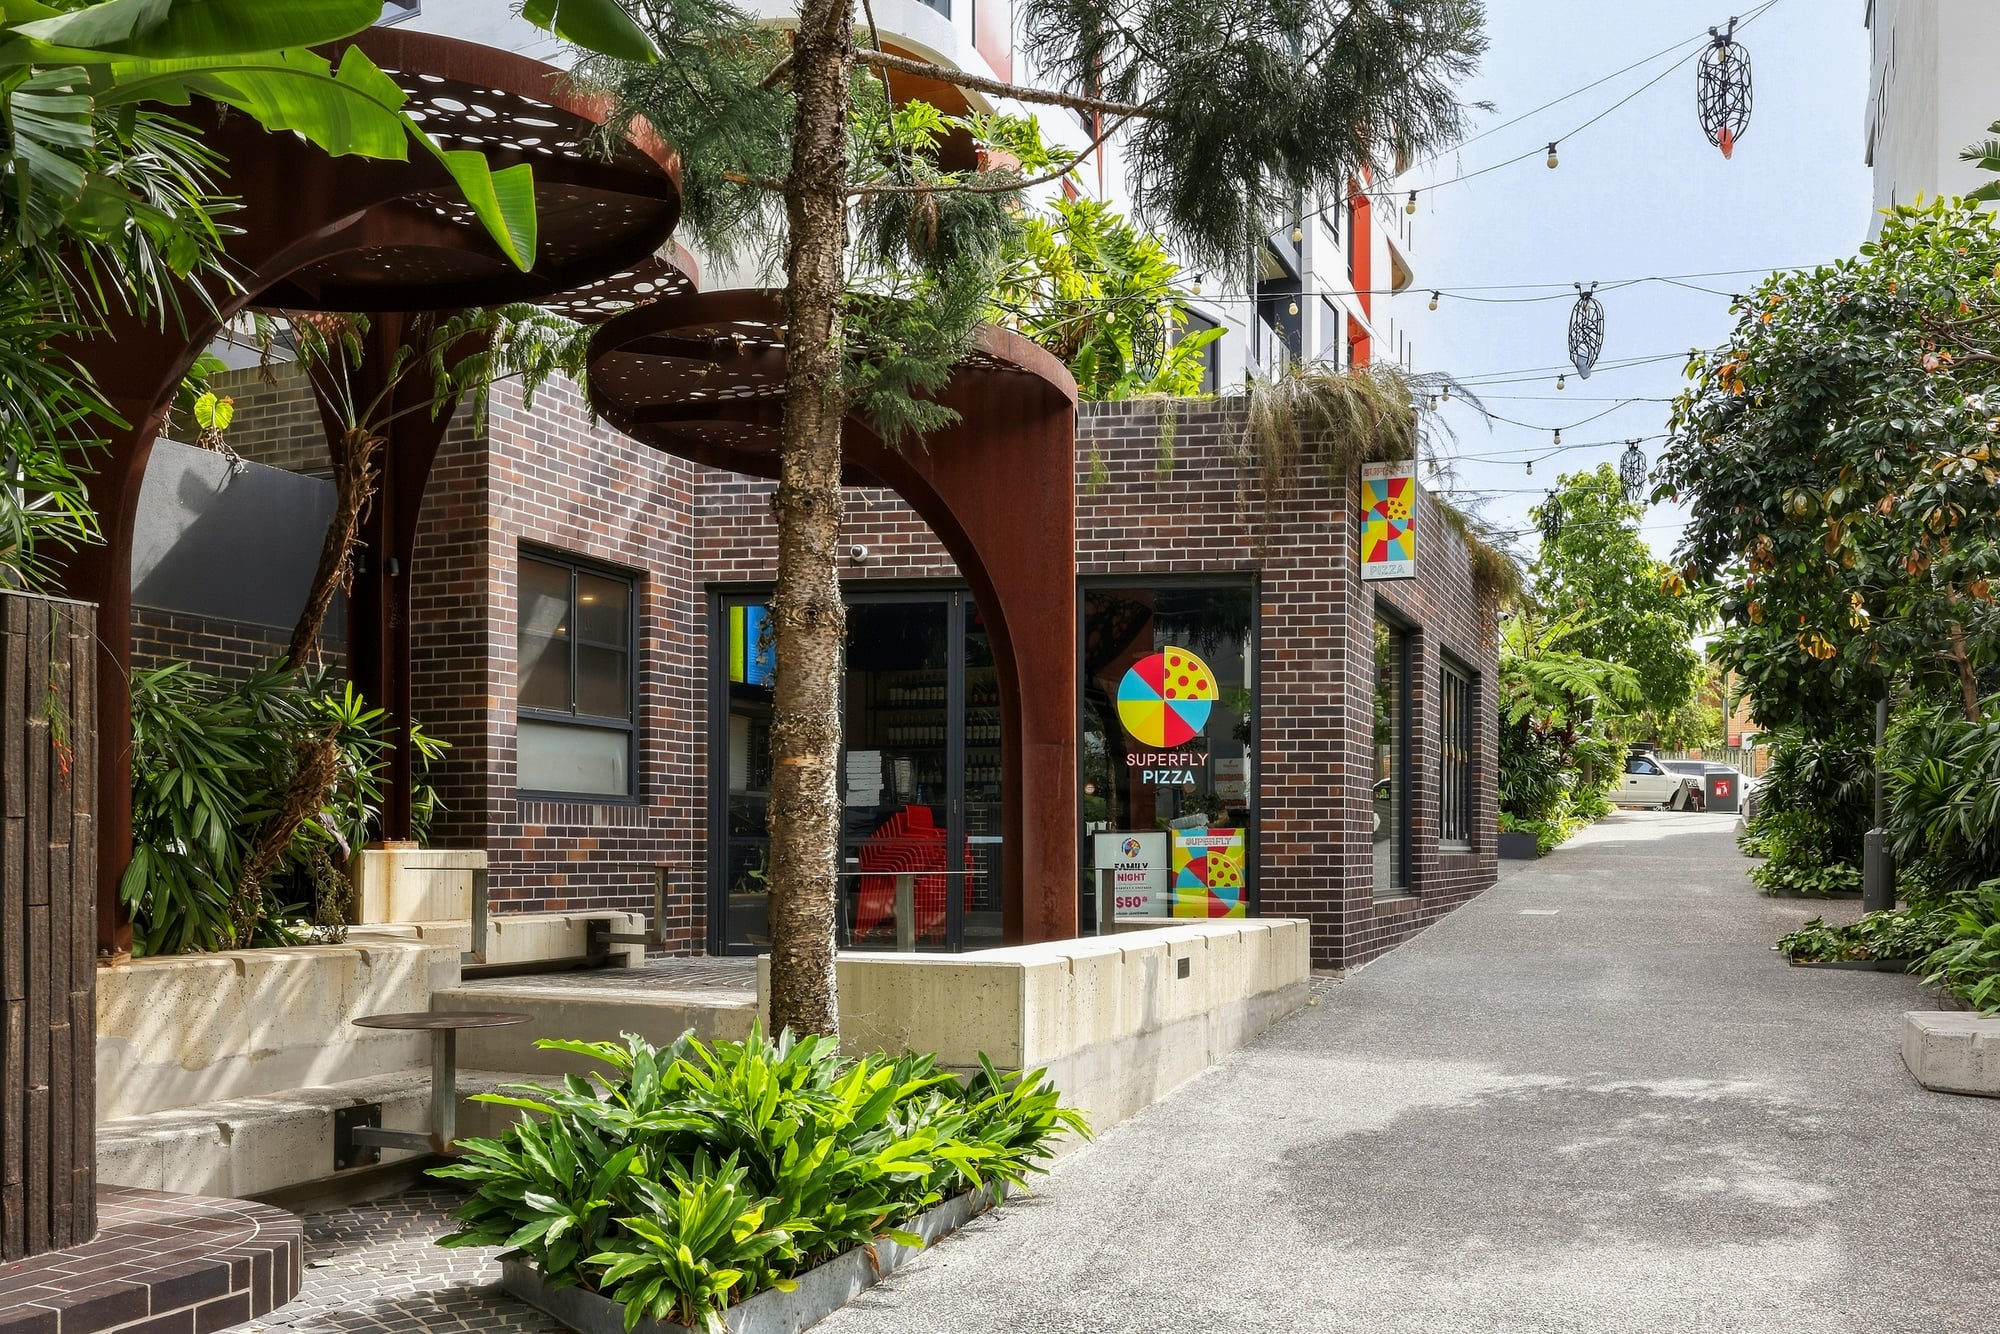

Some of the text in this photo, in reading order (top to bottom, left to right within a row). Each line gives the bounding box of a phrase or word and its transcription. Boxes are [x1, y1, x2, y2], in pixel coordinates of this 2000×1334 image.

[1369, 564, 1405, 576] PIZZA
[1126, 753, 1208, 767] SUPERFLY
[1142, 770, 1195, 784] PIZZA
[1185, 837, 1232, 846] SUPERFLY
[1114, 862, 1149, 871] FAMILY
[1117, 873, 1146, 882] NIGHT
